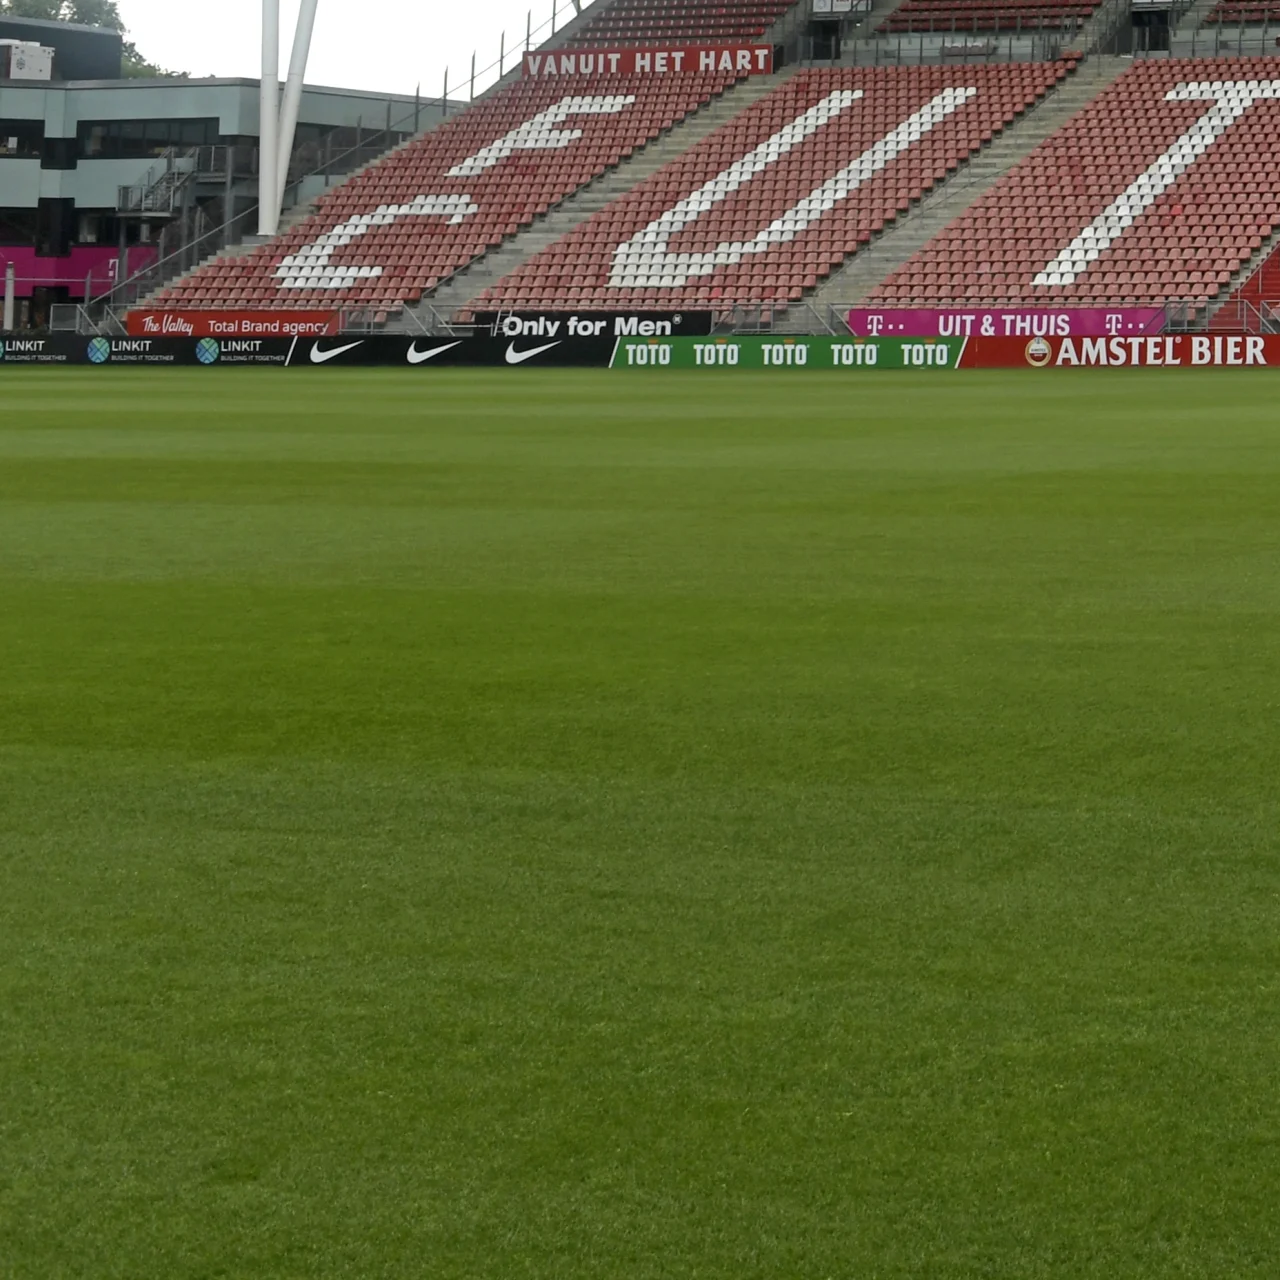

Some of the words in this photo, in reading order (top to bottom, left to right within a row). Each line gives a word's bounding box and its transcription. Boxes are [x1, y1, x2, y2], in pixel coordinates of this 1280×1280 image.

[527, 52, 620, 74] VANUIT
[635, 51, 685, 73] HET
[700, 48, 768, 71] HART
[142, 316, 161, 332] The
[162, 314, 194, 336] Valley
[208, 320, 240, 333] Total
[242, 320, 278, 333] Brand
[282, 322, 329, 336] agency
[504, 316, 560, 336] Only
[567, 316, 606, 336] for
[938, 315, 975, 336] UIT
[980, 315, 995, 336] &
[1002, 314, 1070, 336] THUIS
[5, 341, 45, 351] LINKIT
[112, 341, 152, 351] LINKIT
[221, 341, 262, 351] LINKIT
[1190, 336, 1267, 365] BIER
